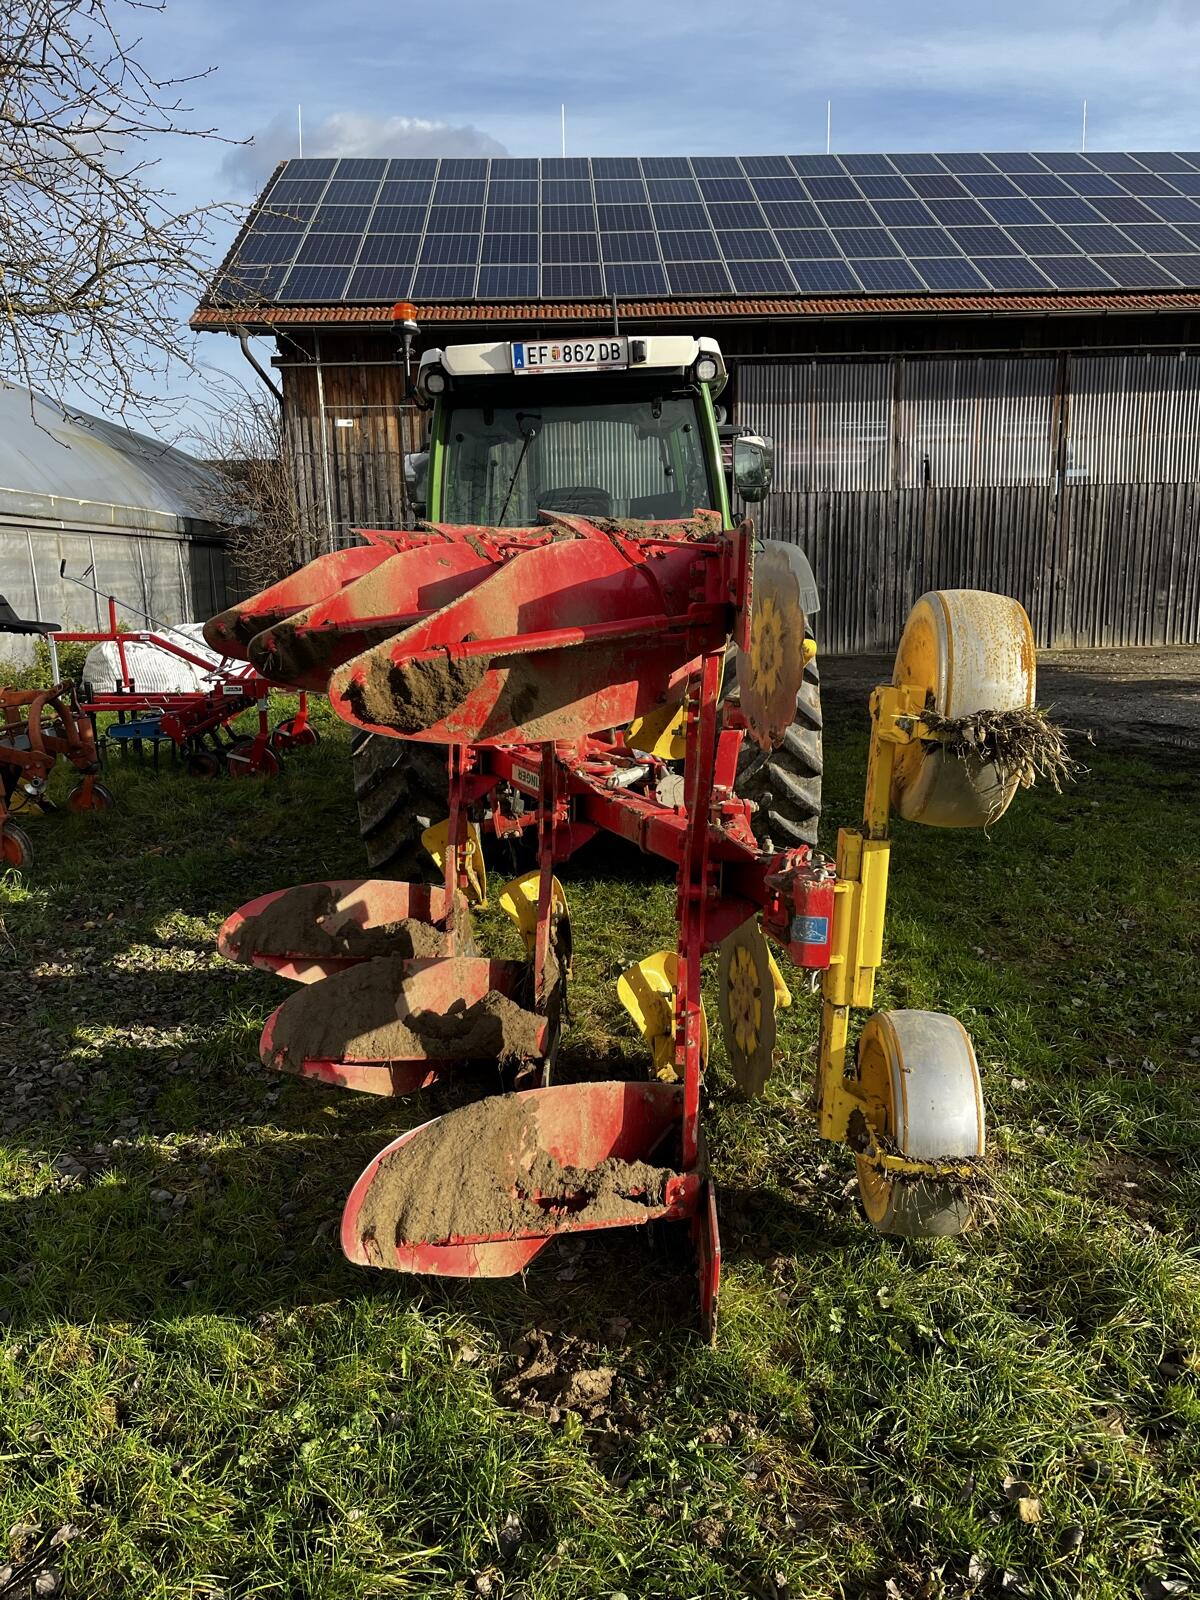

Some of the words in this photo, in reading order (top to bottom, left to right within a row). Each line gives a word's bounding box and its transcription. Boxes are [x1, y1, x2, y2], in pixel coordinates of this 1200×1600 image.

[528, 346, 548, 364] EF
[563, 344, 595, 363] 862
[599, 343, 621, 361] DB
[517, 768, 539, 788] INGER
